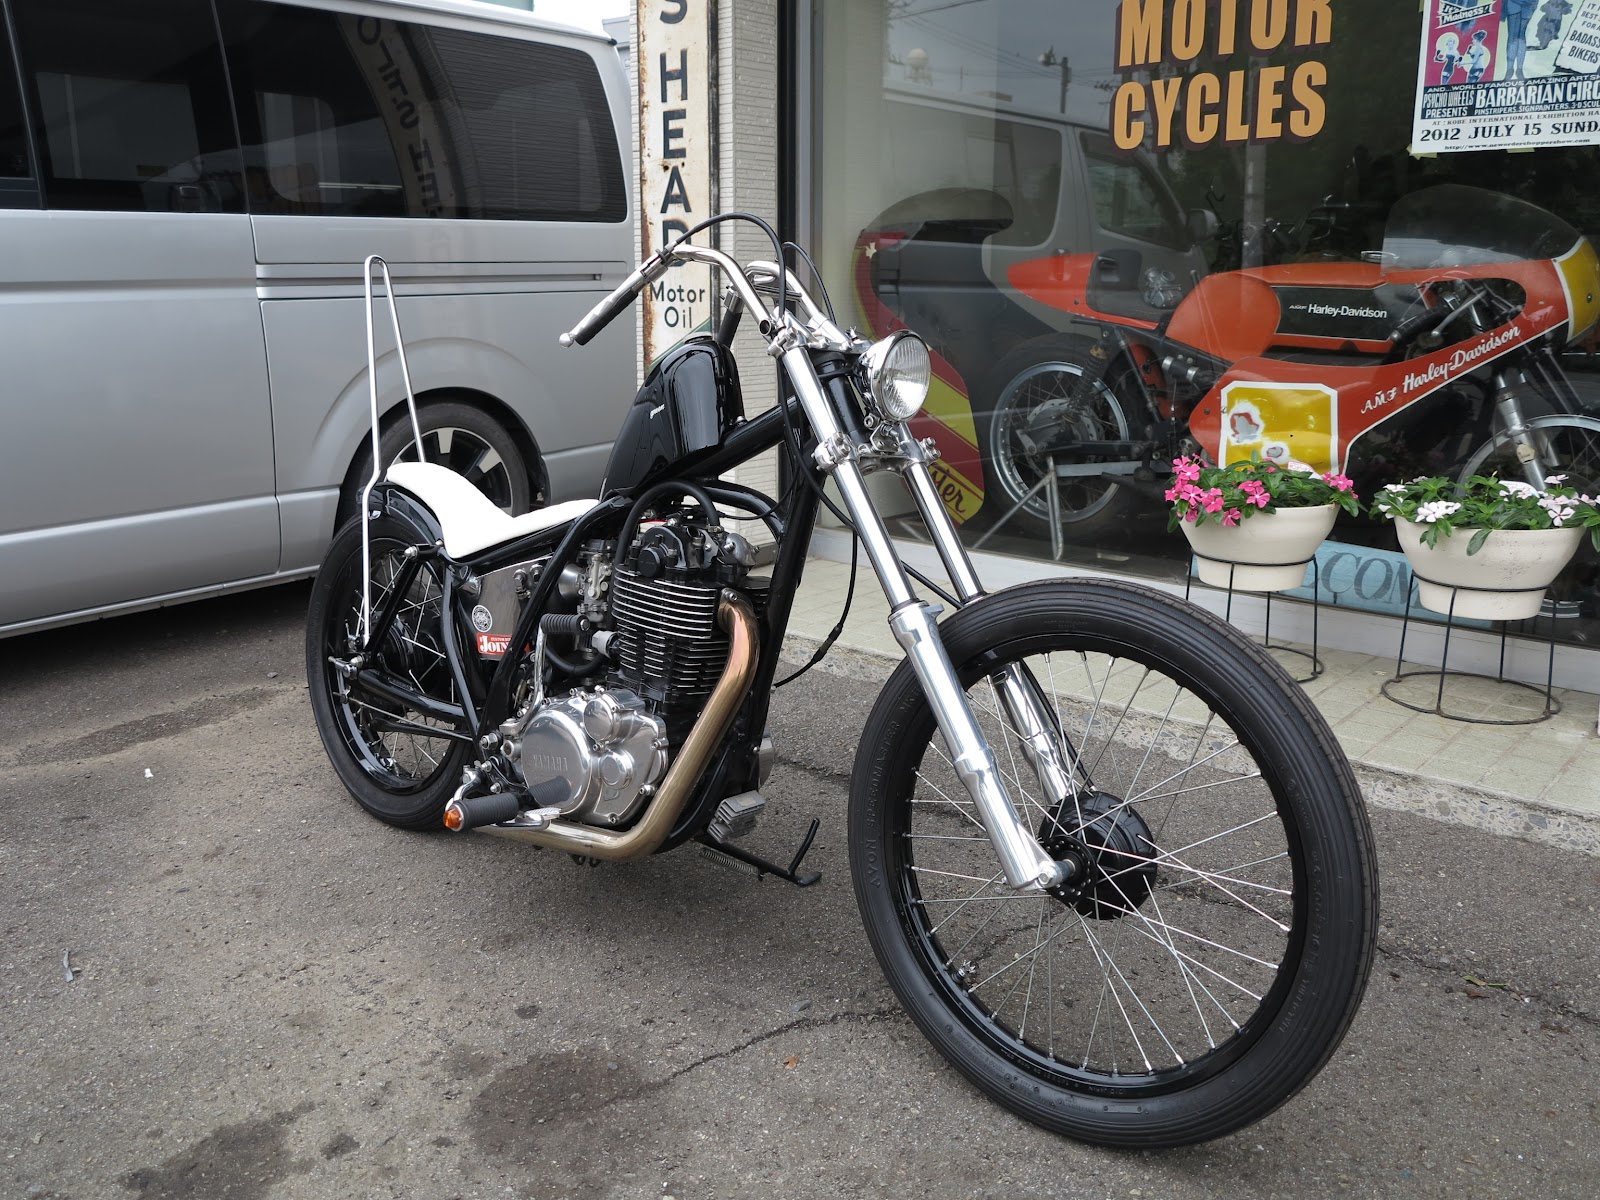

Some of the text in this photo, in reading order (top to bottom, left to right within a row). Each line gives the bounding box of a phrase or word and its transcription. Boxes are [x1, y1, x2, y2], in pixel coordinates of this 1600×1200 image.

[1581, 11, 1598, 20] BEST
[1116, 0, 1332, 67] MOTOR
[1582, 21, 1596, 30] FOR
[1569, 30, 1600, 48] BADASS
[1568, 46, 1600, 63] BIKERS
[1526, 78, 1568, 86] AMAZING
[1448, 90, 1474, 107] WHEELS
[1475, 82, 1564, 109] BARBARIAN
[1112, 61, 1327, 150] CYCLES
[1425, 107, 1468, 119] PRESENTS
[1469, 116, 1534, 124] INTERNATIONAL
[1420, 128, 1461, 141] 2012
[1468, 124, 1515, 139] JULY
[1523, 123, 1542, 136] 15
[660, 48, 692, 267] HEAD
[650, 281, 705, 303] Motor
[664, 306, 692, 328] Oil
[1308, 303, 1388, 318] Harley-Davidson
[1402, 326, 1521, 394] Harley-Davidson
